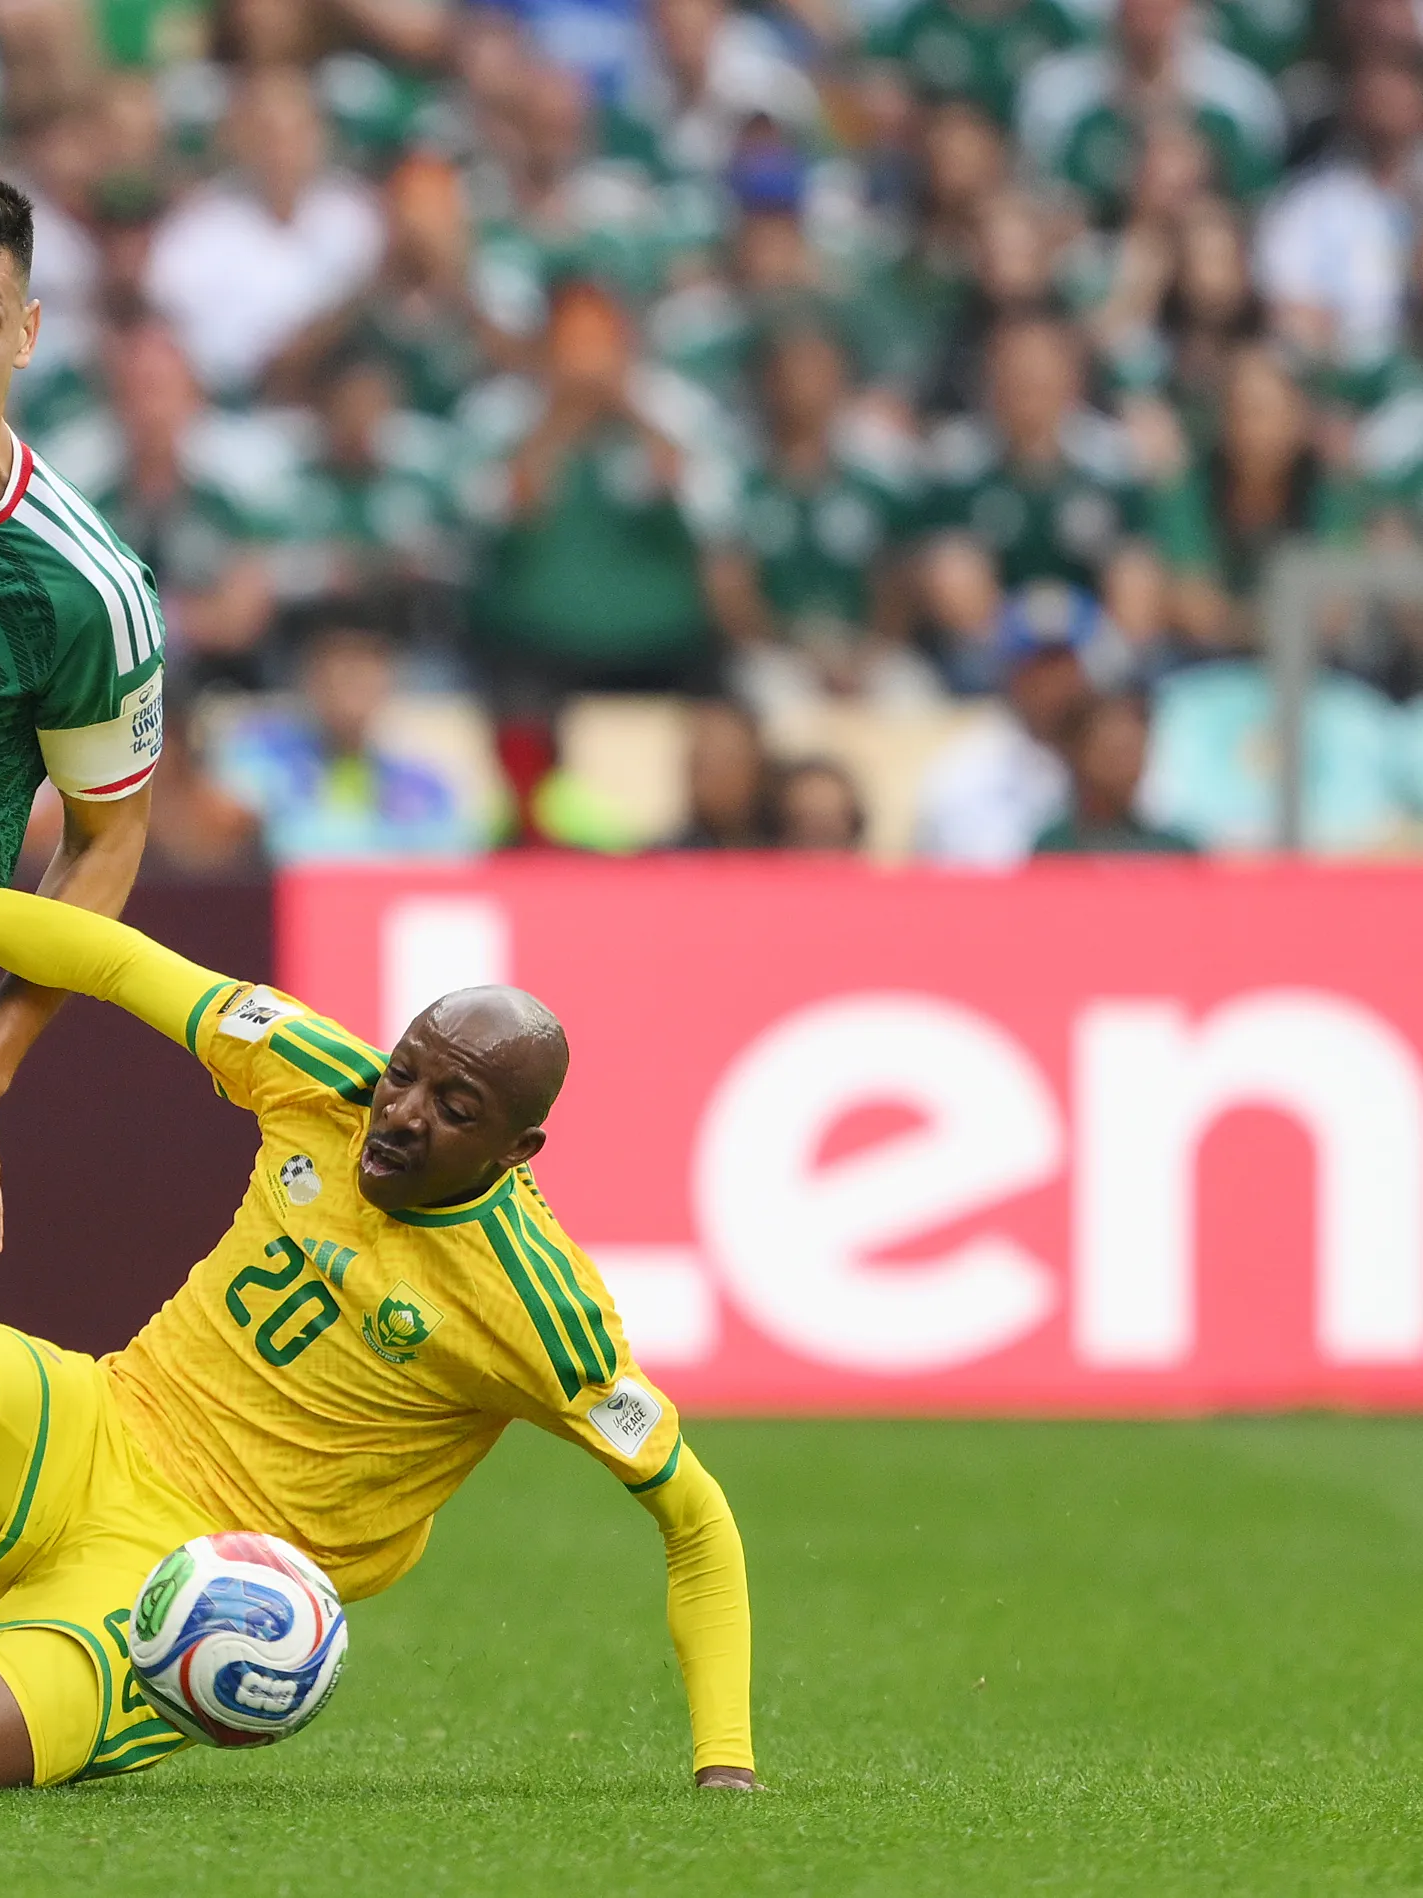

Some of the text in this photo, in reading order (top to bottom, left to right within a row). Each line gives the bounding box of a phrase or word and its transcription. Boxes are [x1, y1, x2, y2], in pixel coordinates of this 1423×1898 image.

[130, 737, 154, 754] the
[224, 1235, 341, 1368] 20
[621, 1407, 647, 1436] PEACE
